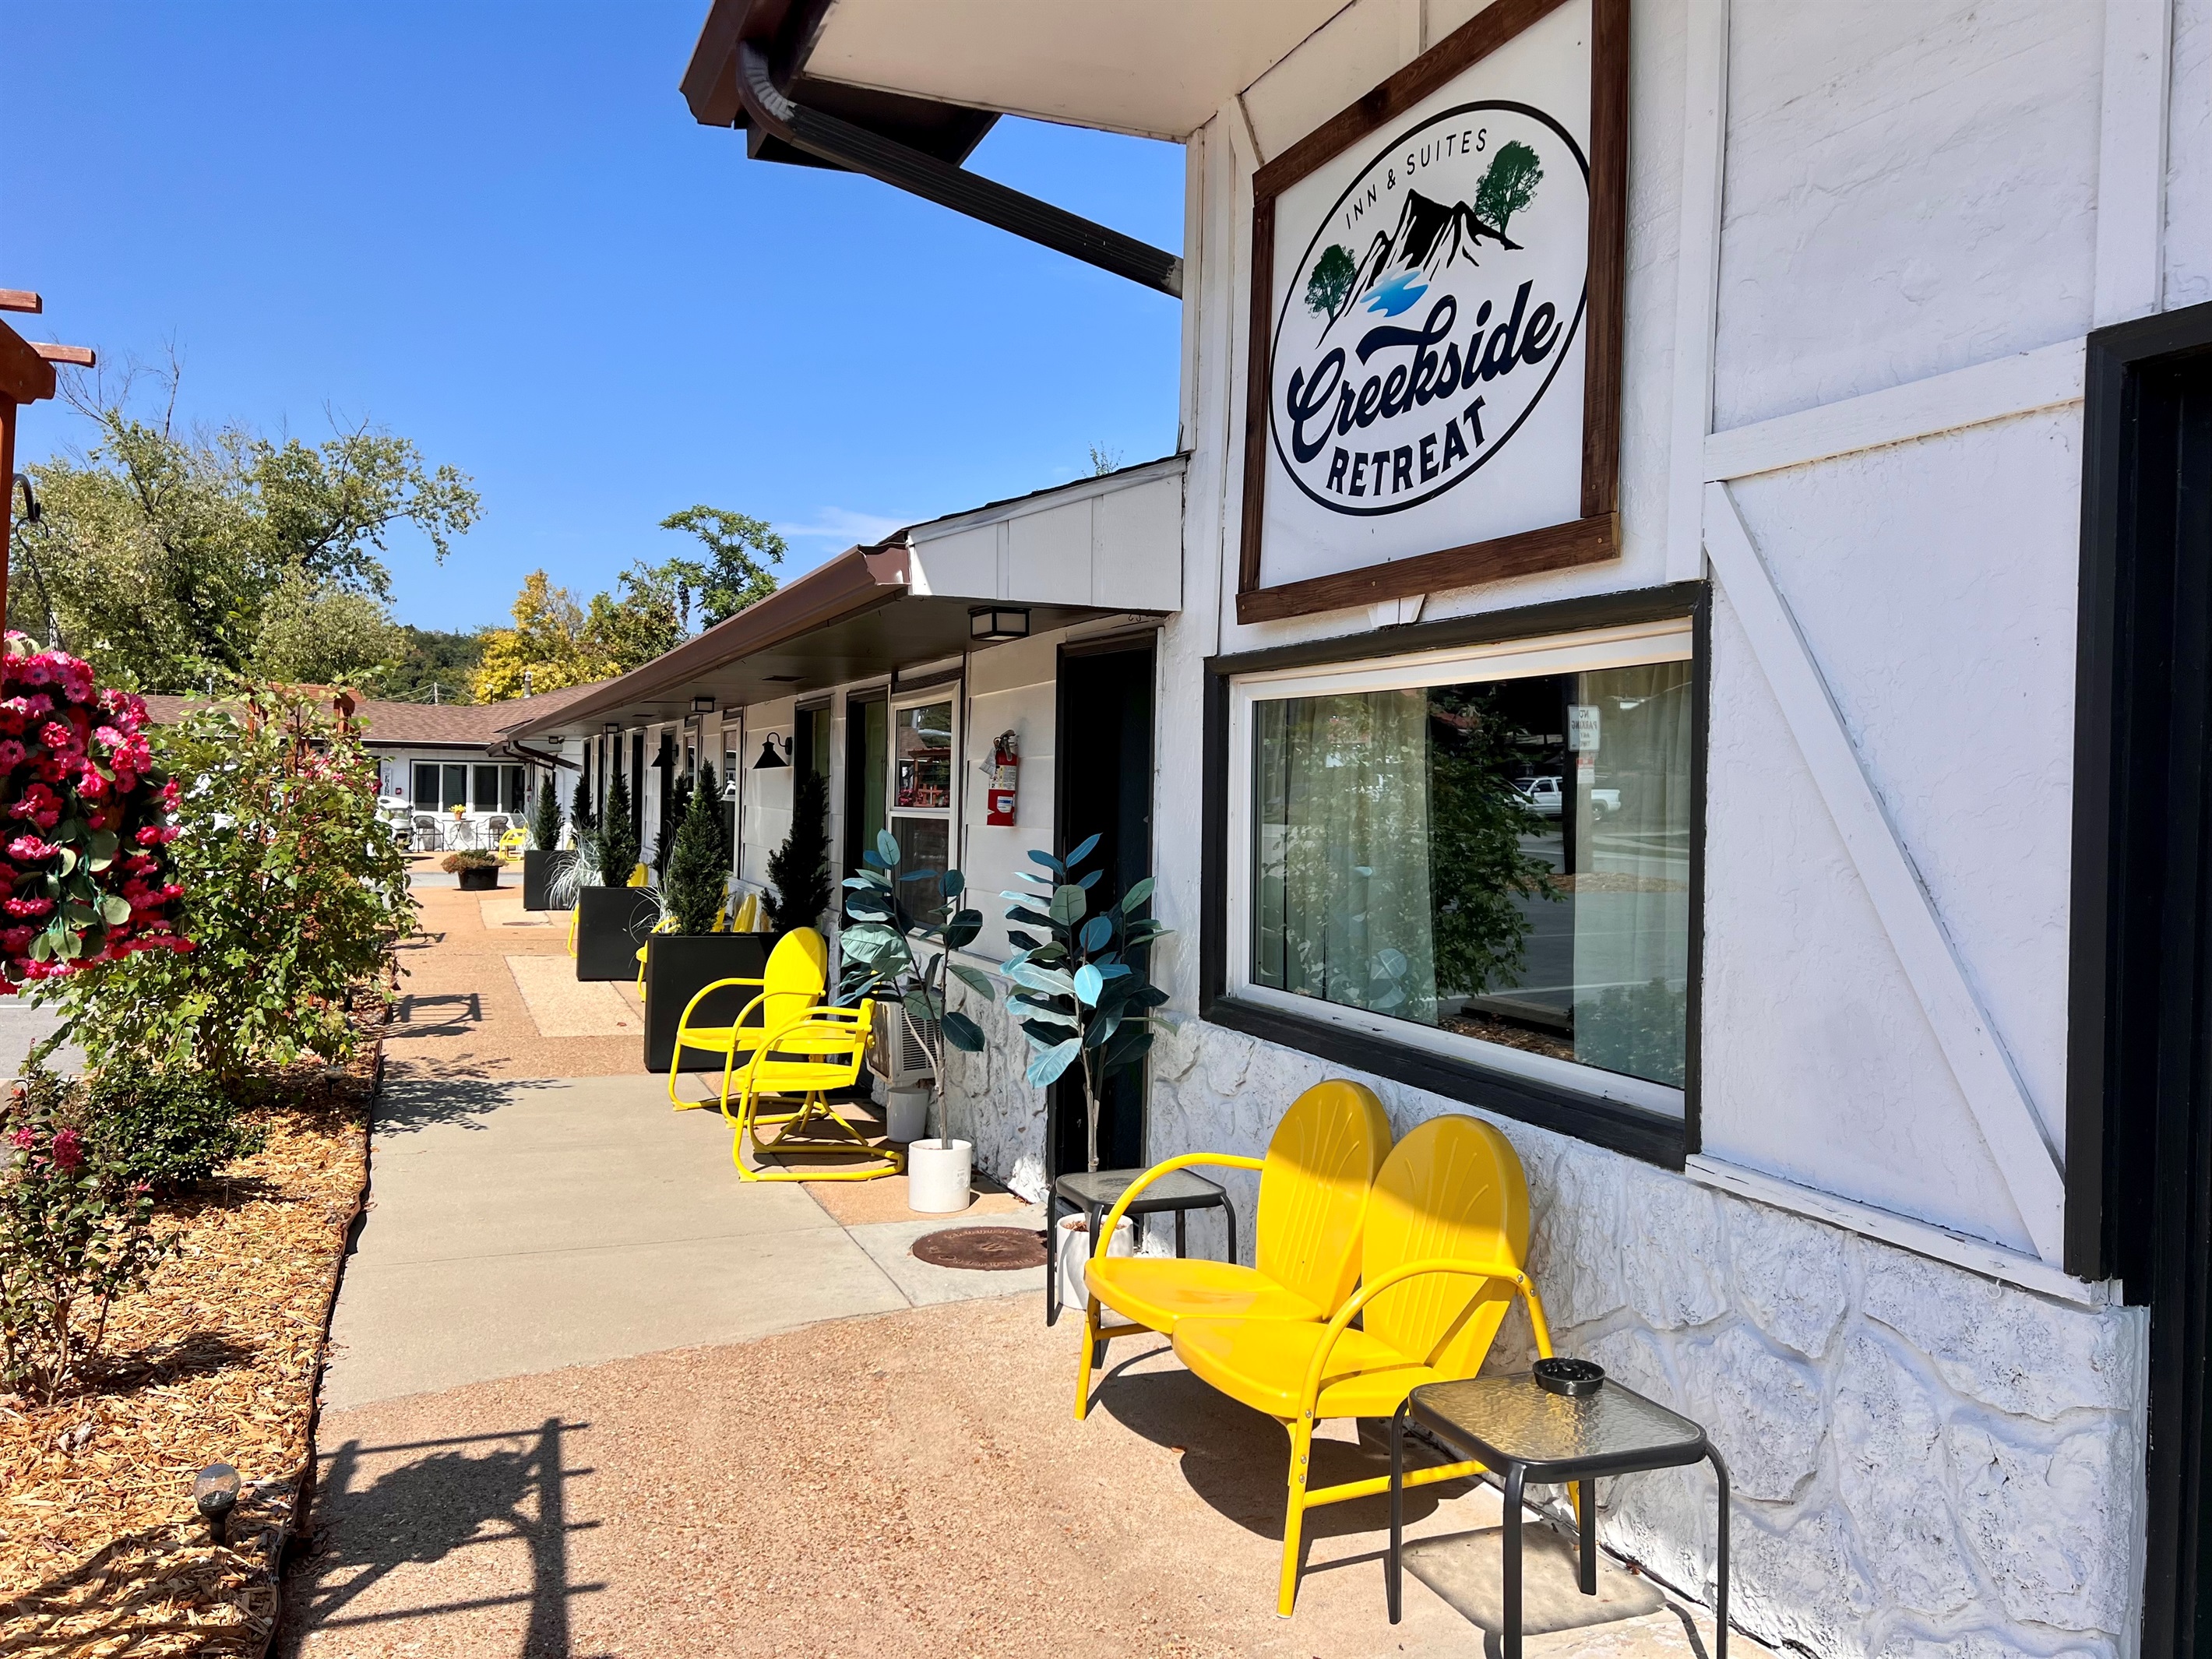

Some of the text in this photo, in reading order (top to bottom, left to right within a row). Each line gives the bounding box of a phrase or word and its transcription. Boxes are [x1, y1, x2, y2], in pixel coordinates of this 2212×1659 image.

[1346, 129, 1487, 230] INN & SUITES
[1287, 279, 1563, 463] Creekside
[1326, 395, 1486, 497] RETREAT
